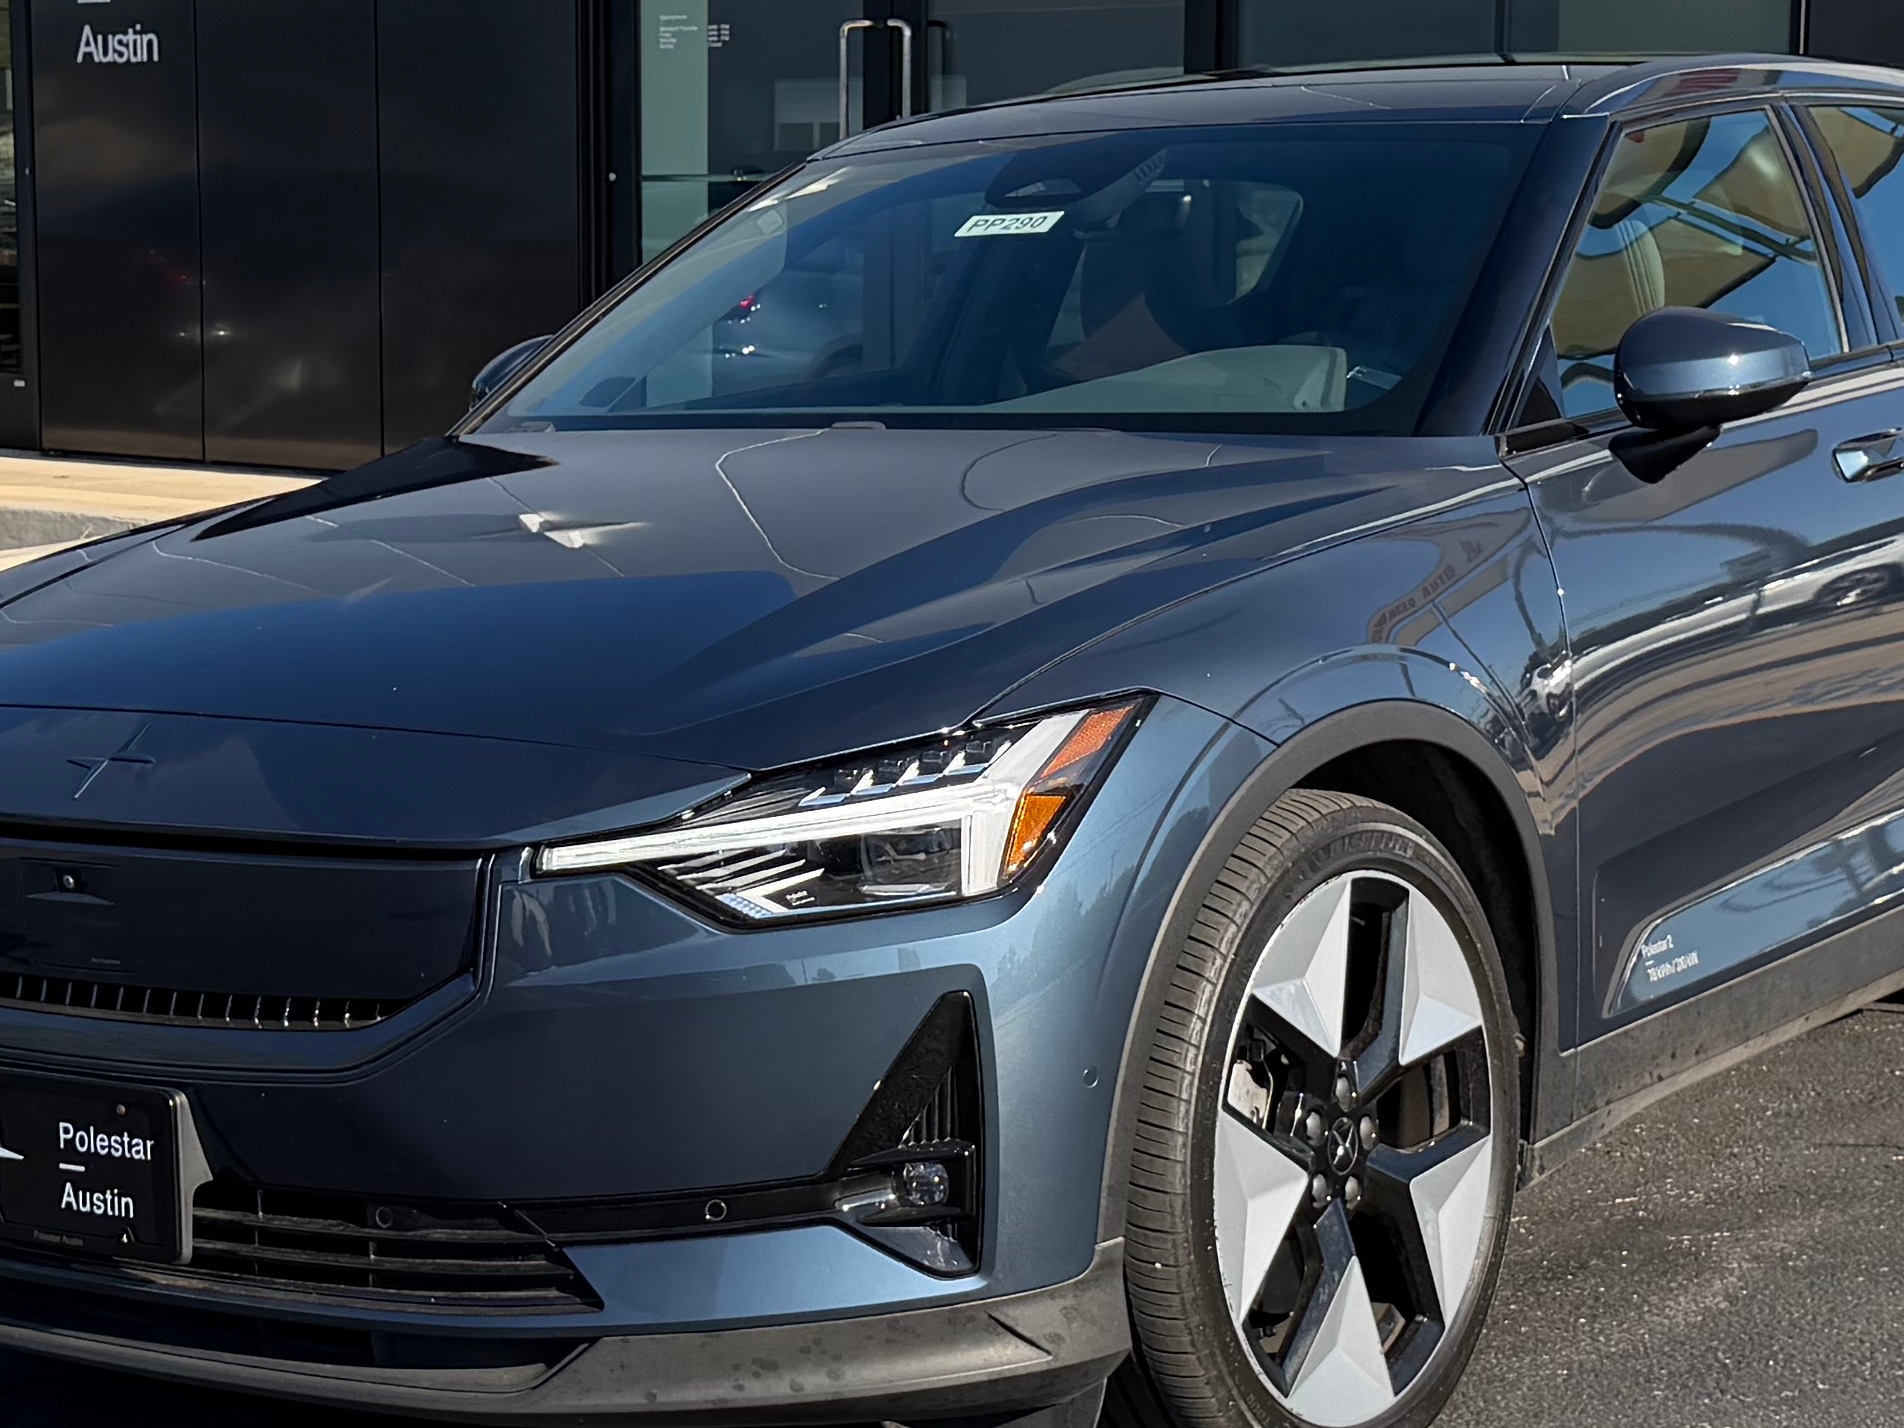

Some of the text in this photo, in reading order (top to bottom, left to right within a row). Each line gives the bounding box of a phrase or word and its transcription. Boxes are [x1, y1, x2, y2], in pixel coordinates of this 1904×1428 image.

[76, 24, 159, 64] Austin
[965, 215, 1049, 233] PP290
[58, 1121, 155, 1162] Polestar
[60, 1181, 134, 1219] Austin
